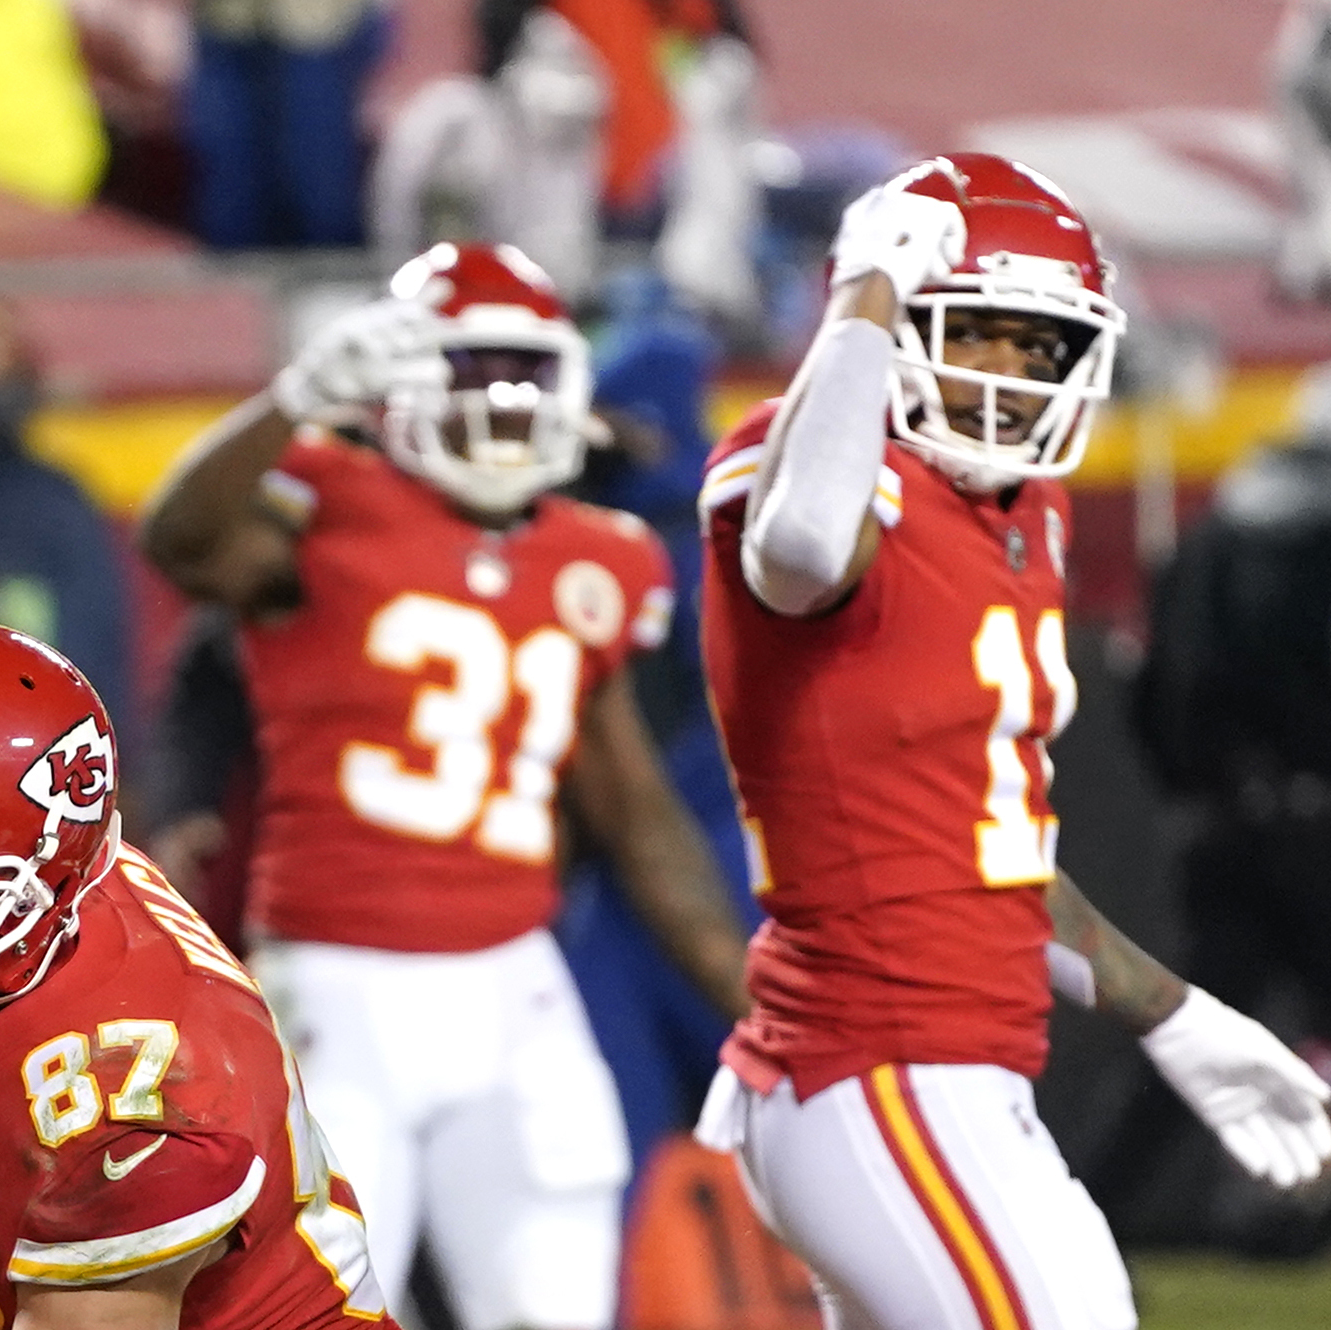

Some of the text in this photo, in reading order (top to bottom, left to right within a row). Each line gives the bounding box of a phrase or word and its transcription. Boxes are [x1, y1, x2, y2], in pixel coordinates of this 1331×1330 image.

[46, 743, 107, 808] KC
[337, 590, 584, 867] 31
[21, 1018, 180, 1149] 87
